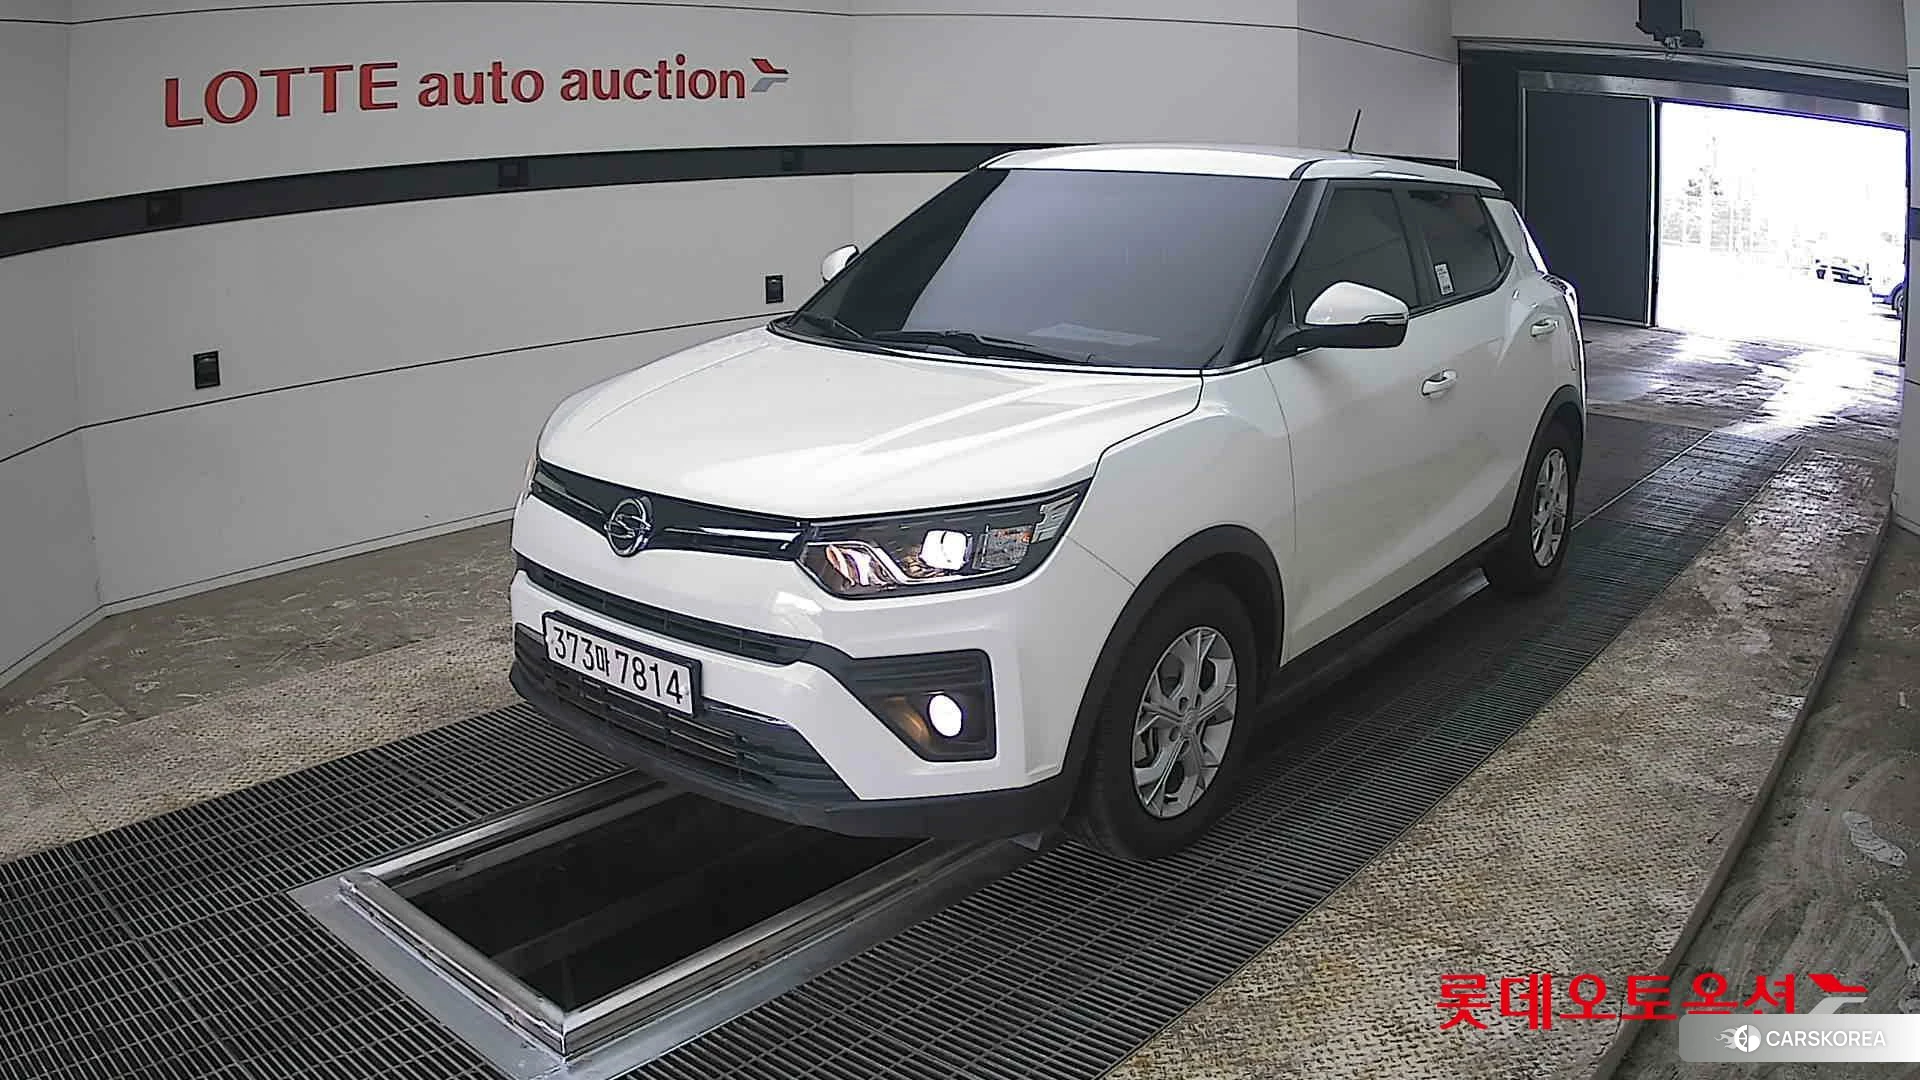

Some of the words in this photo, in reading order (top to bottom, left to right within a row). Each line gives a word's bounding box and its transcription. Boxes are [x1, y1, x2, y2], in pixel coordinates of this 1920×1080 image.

[164, 61, 399, 128] LOTTE
[418, 61, 545, 107] auto
[560, 53, 746, 101] auction
[553, 626, 611, 677] 373마
[615, 650, 683, 704] 7814
